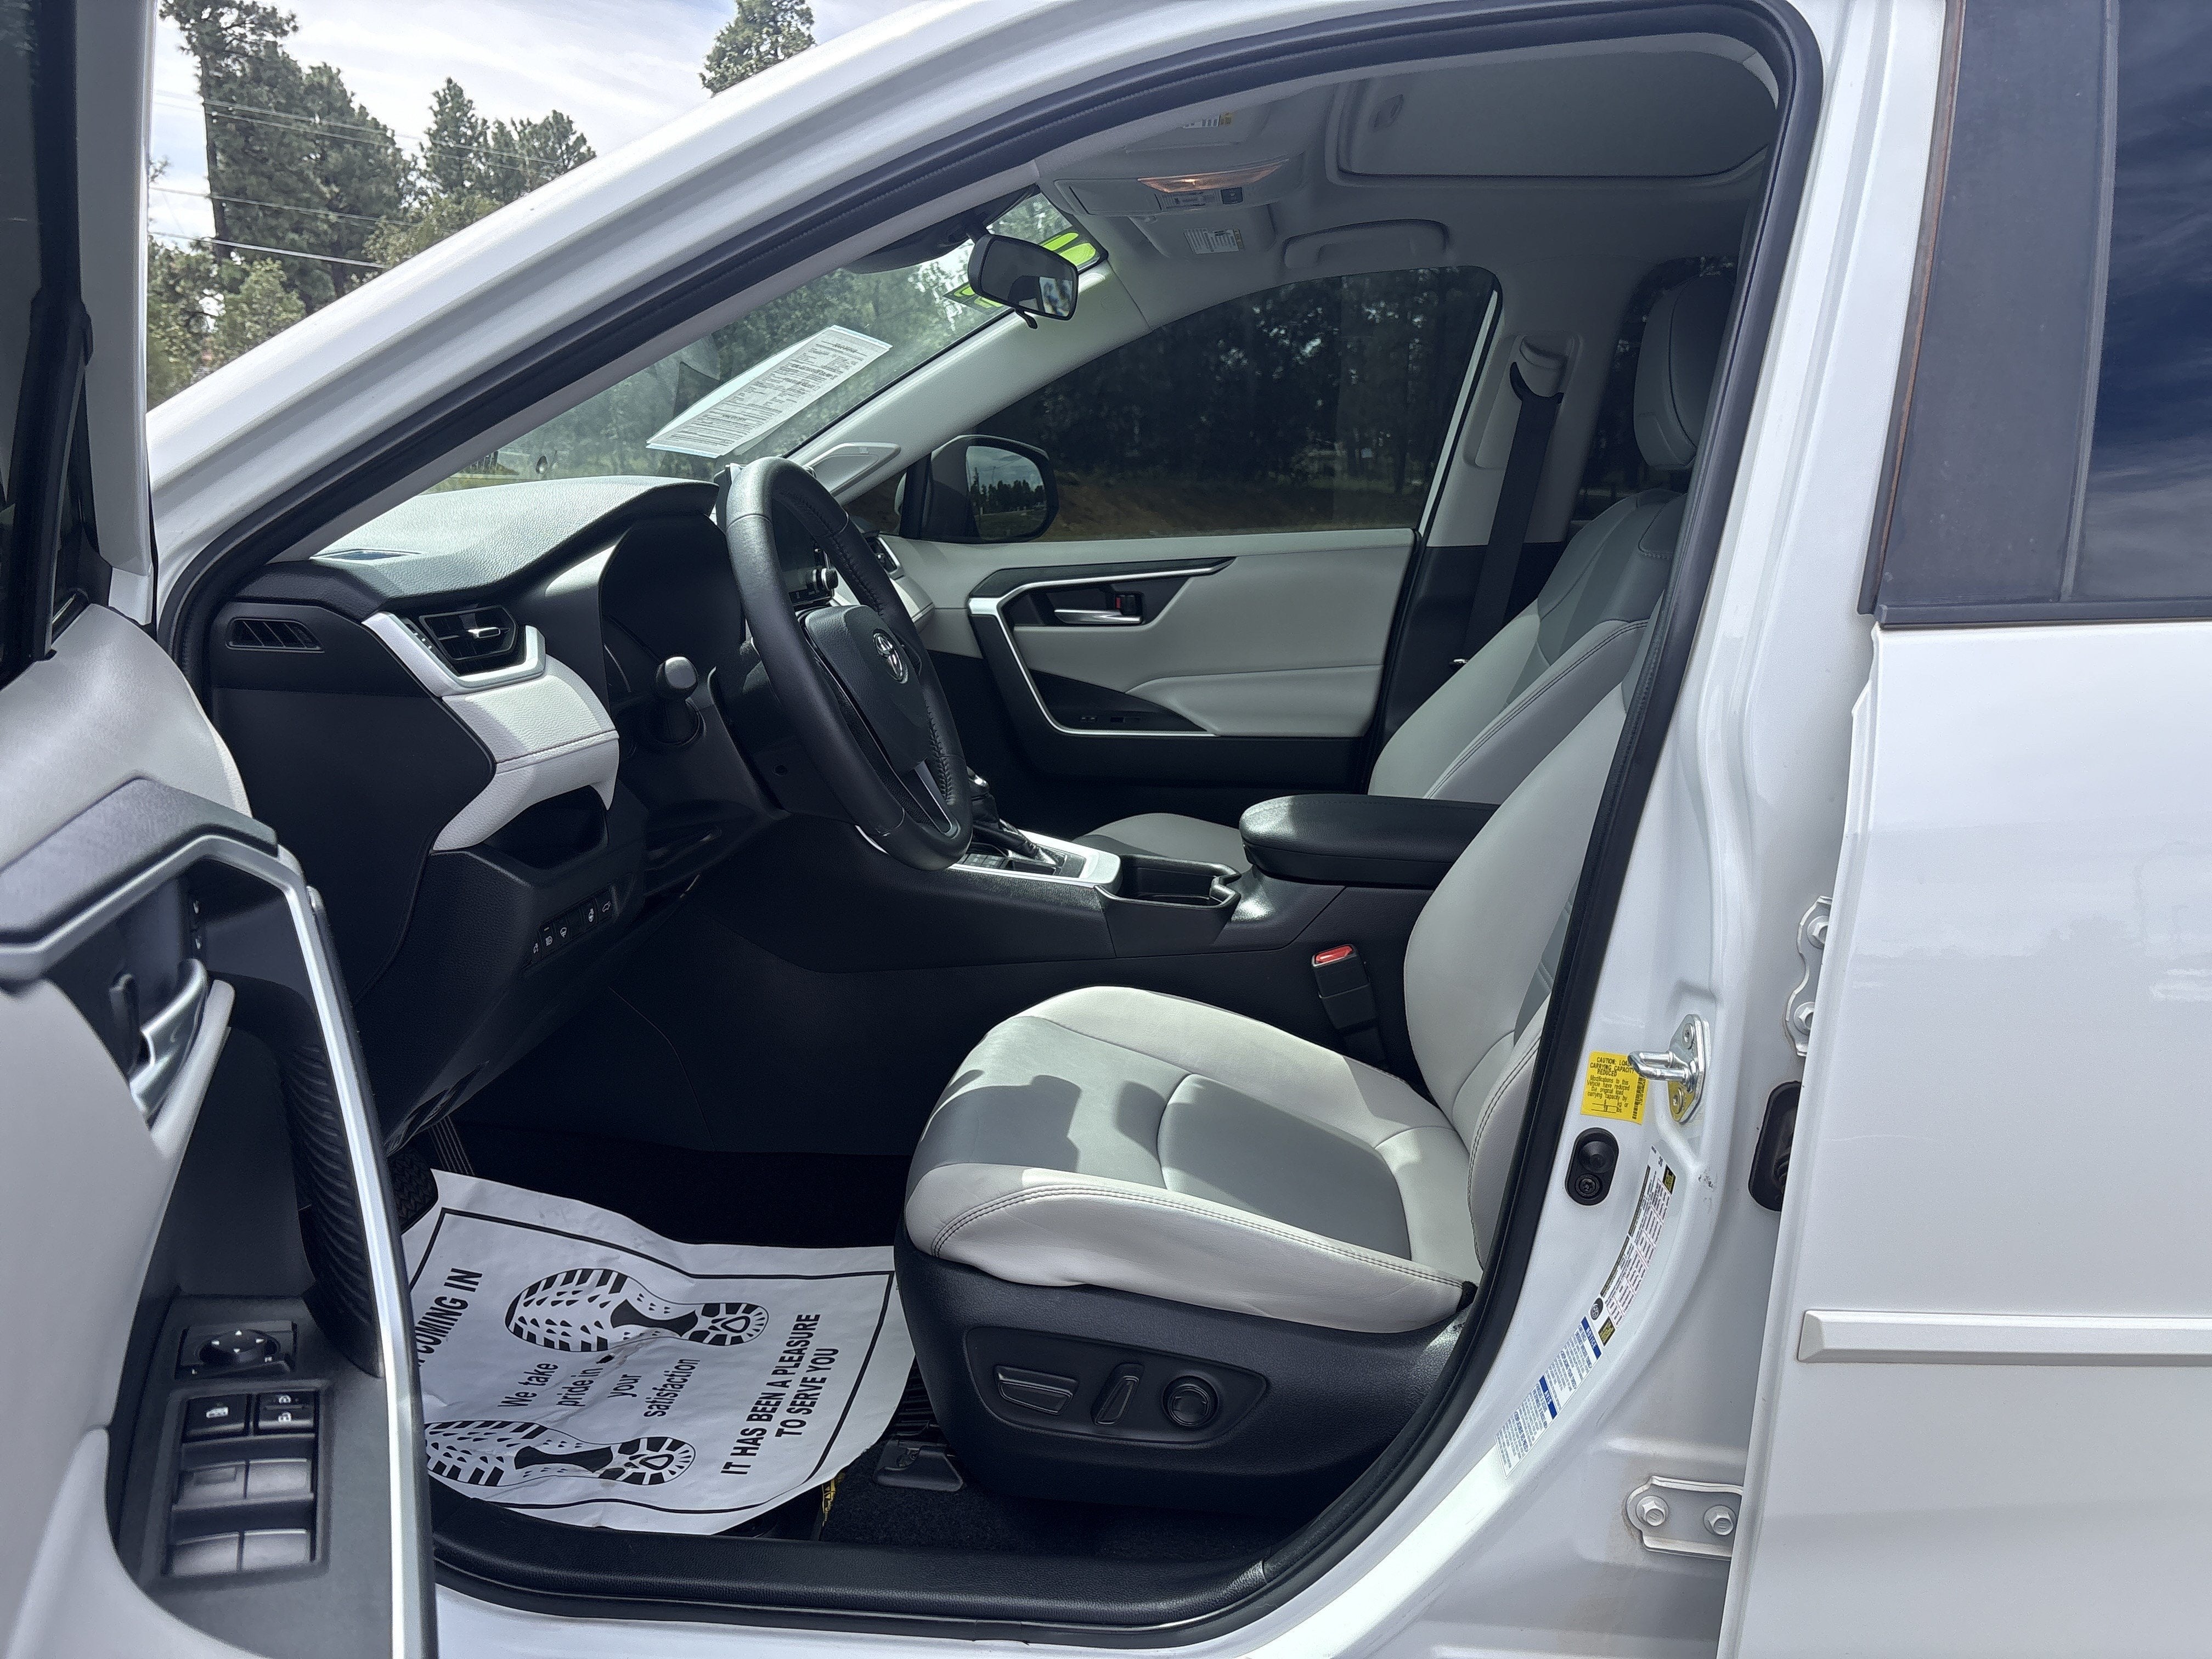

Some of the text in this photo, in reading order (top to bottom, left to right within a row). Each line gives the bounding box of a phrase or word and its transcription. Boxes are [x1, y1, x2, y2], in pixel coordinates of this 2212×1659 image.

[1590, 1062, 1635, 1074] CARRYING CAPACITY
[1596, 1057, 1616, 1065] CAUTION:
[1597, 1068, 1617, 1076] REDUCED
[415, 1268, 483, 1353] COMING IN
[1585, 1326, 1598, 1350] NOTICE
[497, 1363, 558, 1407] We take
[556, 1379, 594, 1407] pride
[607, 1374, 642, 1398] your
[643, 1359, 701, 1417] satisfaction
[720, 1314, 821, 1475] IT HAS BEEN A PLEASURE
[774, 1348, 839, 1437] TO SERVE YOU
[1543, 1389, 1552, 1404] AVIS
